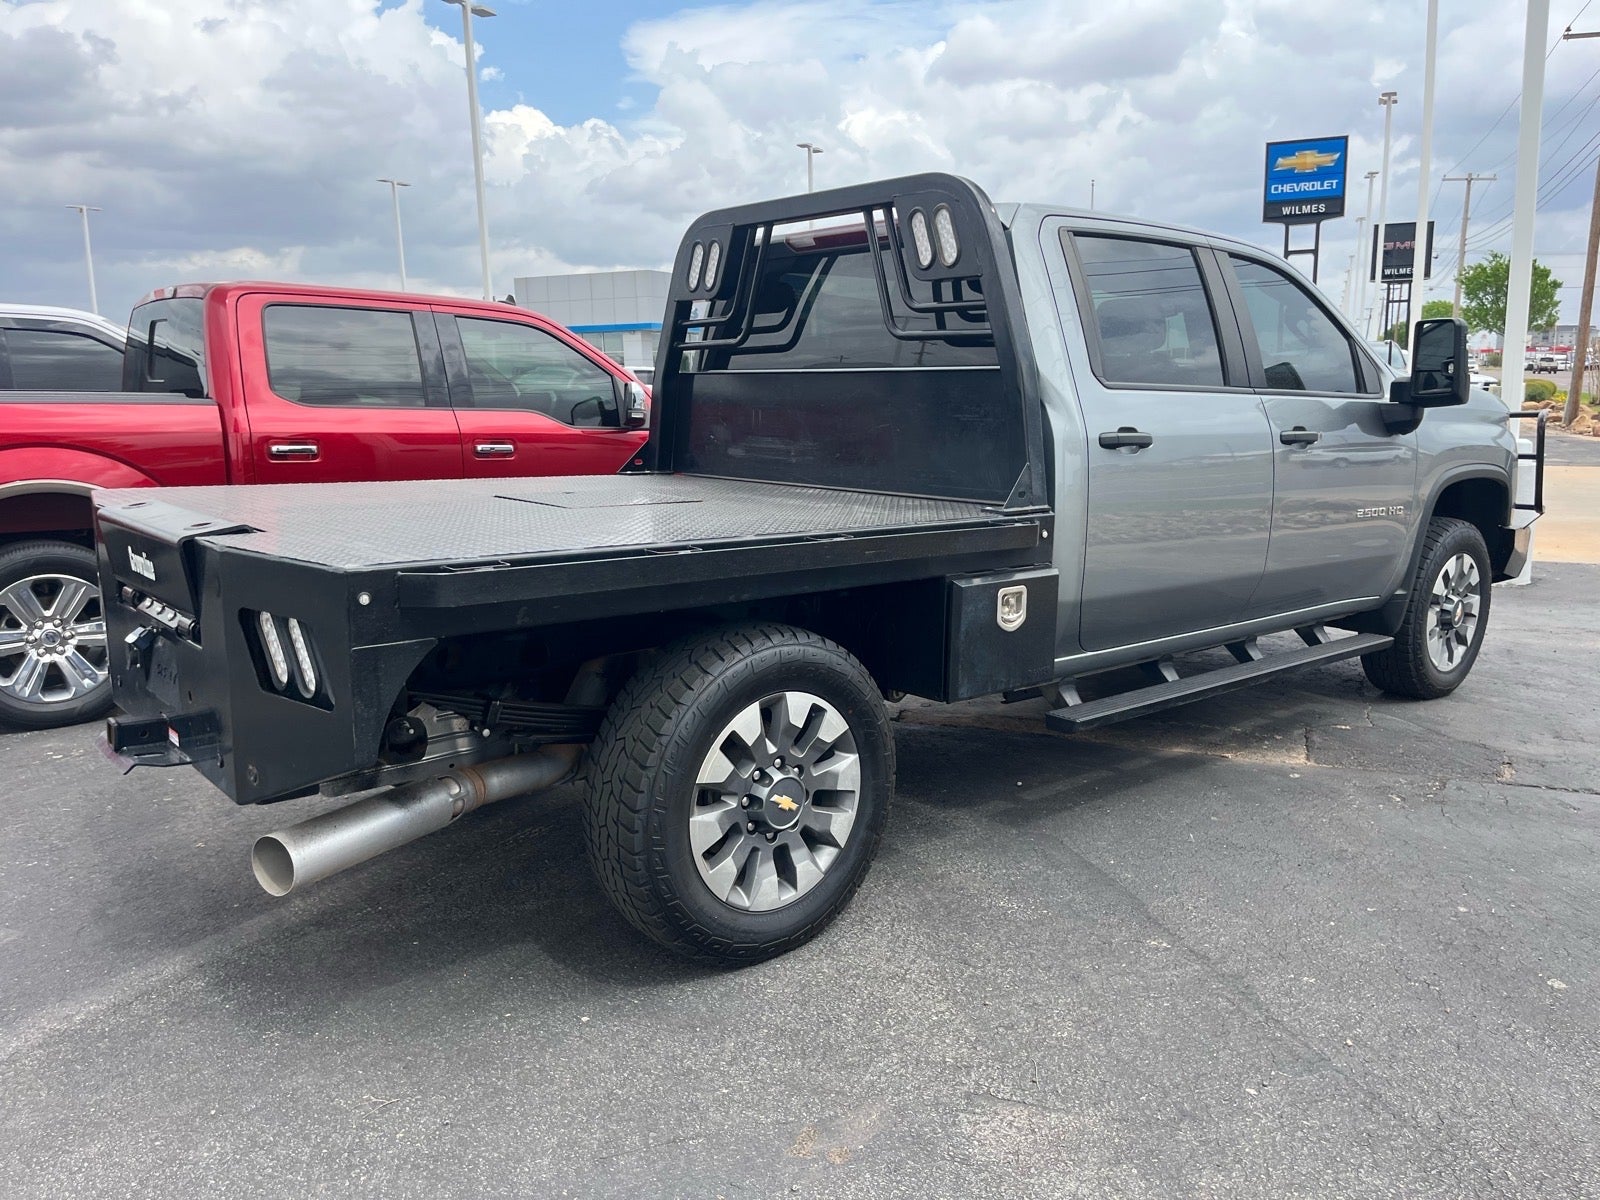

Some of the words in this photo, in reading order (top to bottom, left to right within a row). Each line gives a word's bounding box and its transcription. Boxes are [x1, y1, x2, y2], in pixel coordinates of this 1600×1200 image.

[1271, 180, 1338, 194] CHEVROLET
[1282, 204, 1326, 215] WILMES
[1357, 507, 1386, 518] 2500
[1388, 505, 1404, 516] HD
